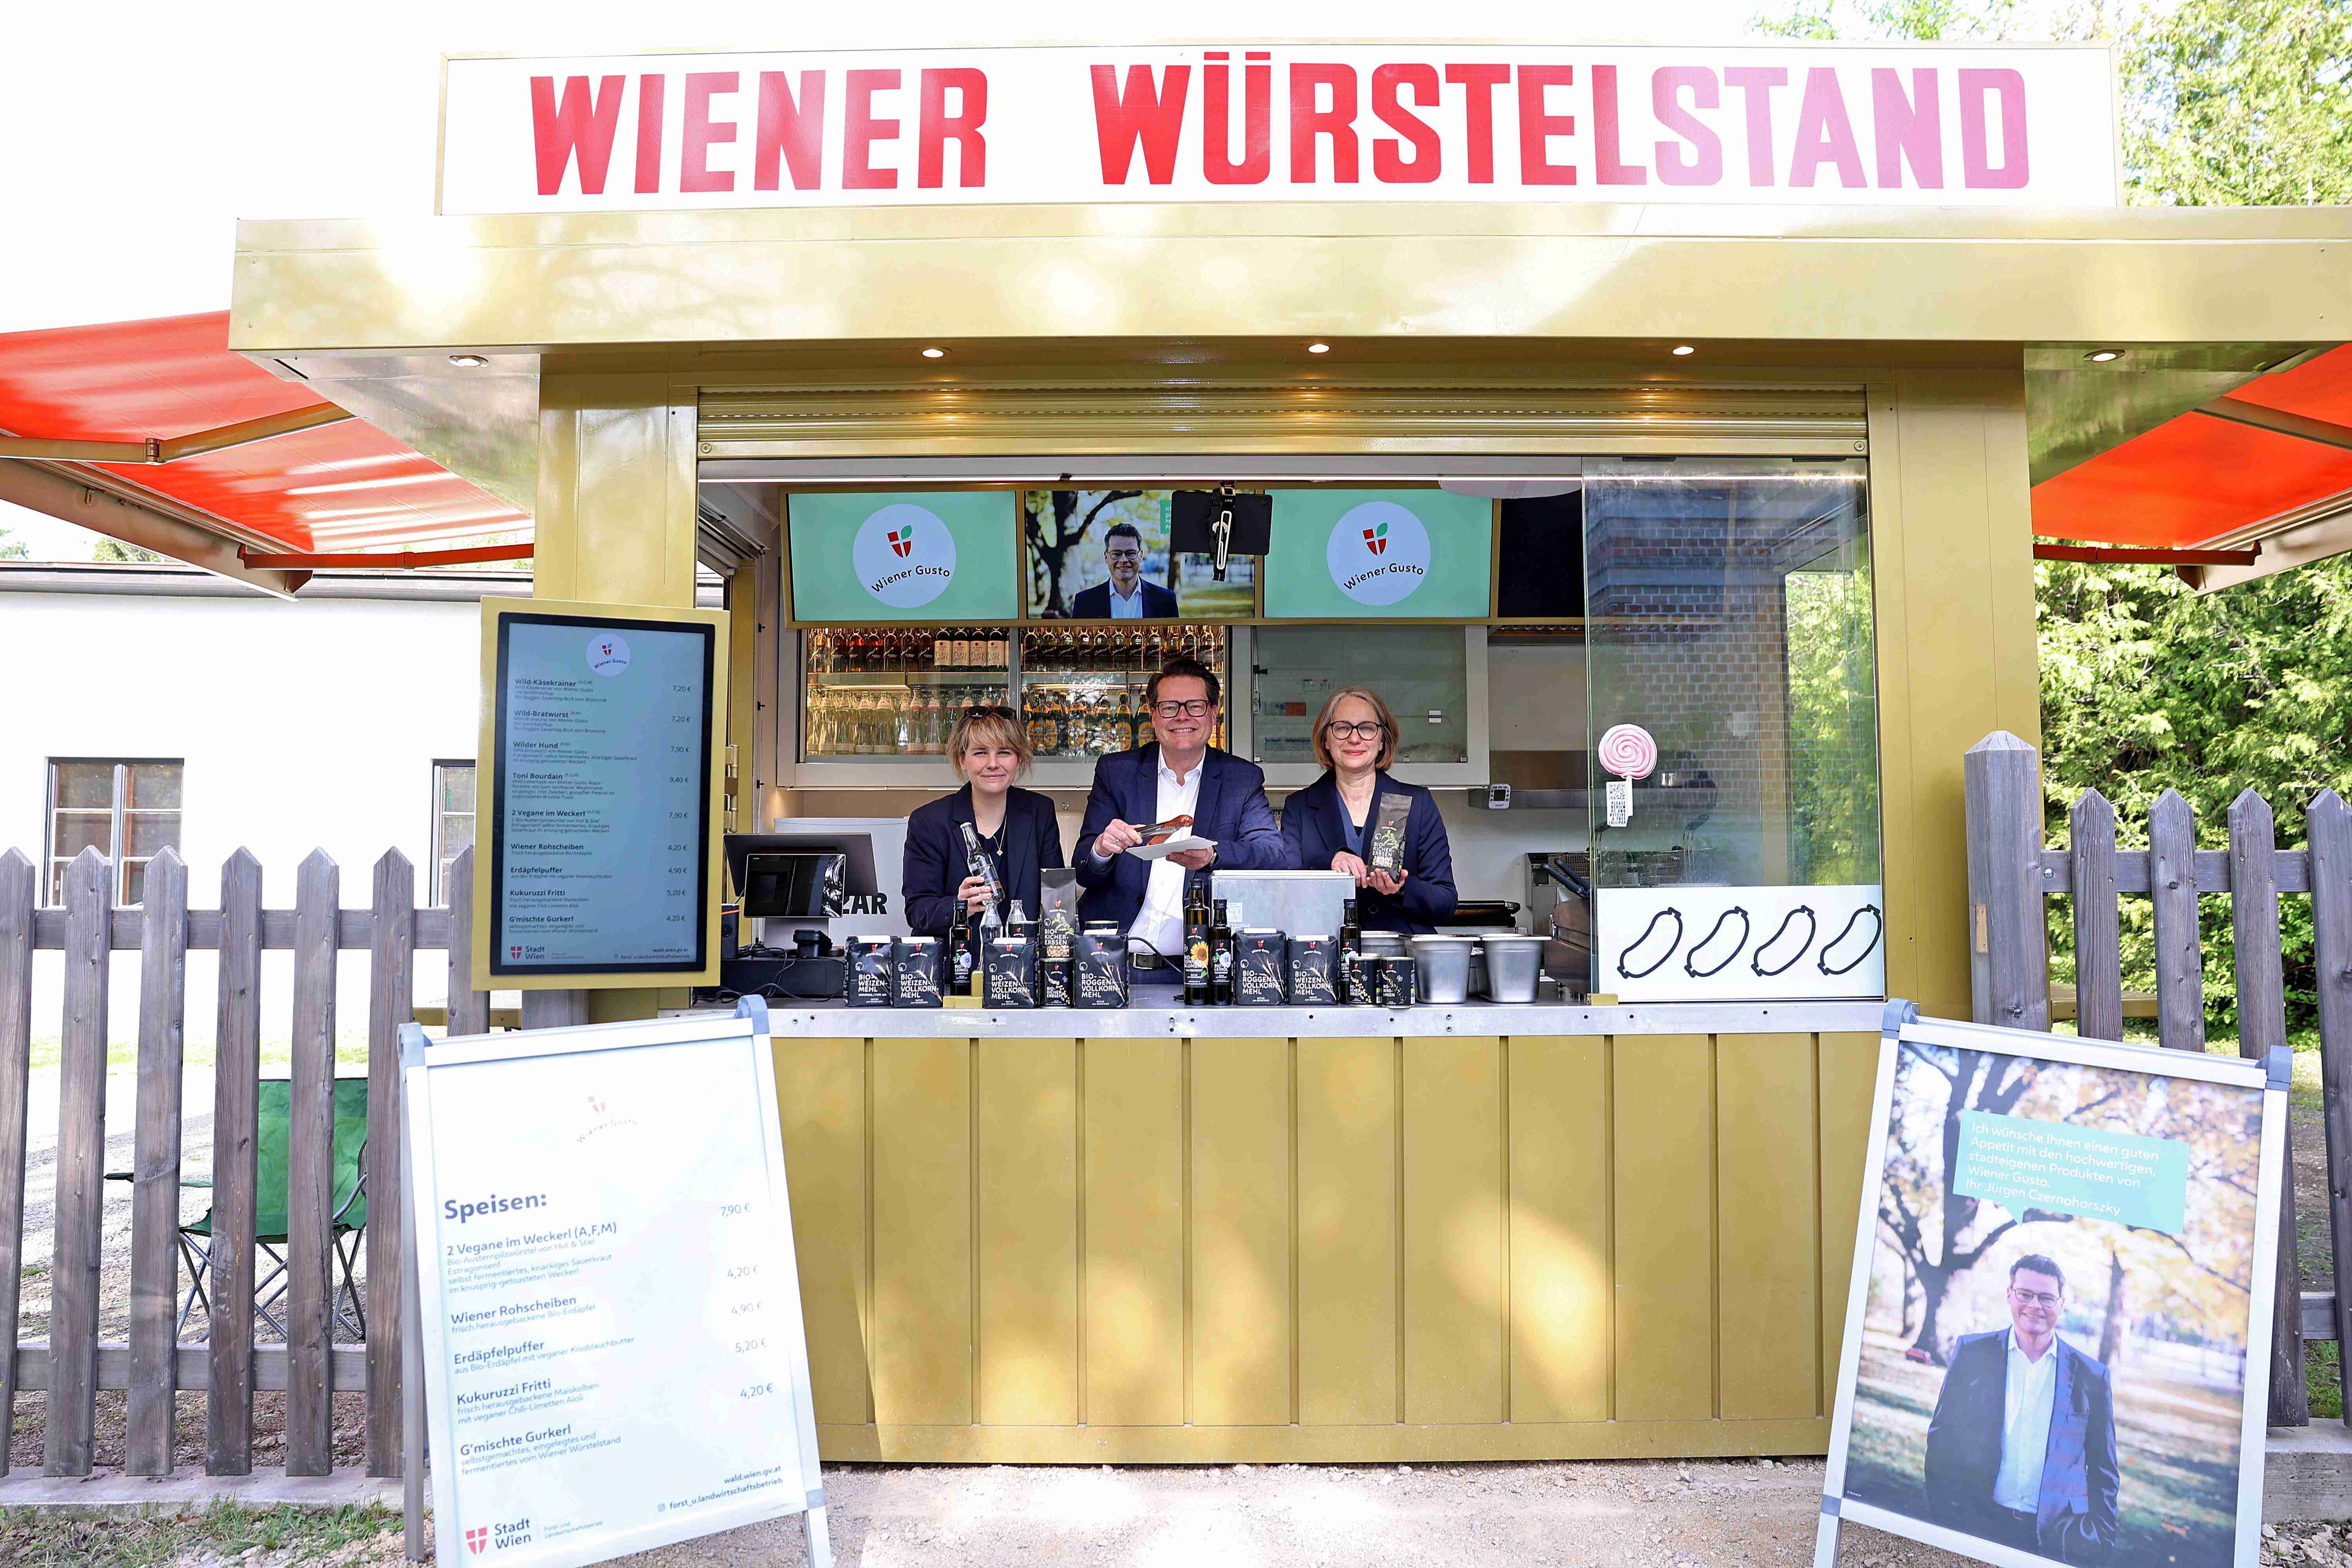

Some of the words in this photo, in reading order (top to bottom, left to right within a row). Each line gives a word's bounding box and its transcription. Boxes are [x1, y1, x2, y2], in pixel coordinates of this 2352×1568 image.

[531, 68, 988, 195] WIENER
[1091, 50, 2029, 189] WÜRSTELSTAND
[871, 567, 913, 594] Wiener
[916, 564, 951, 579] Gusto
[1344, 566, 1386, 590] Wiener
[1389, 562, 1424, 576] Gusto
[594, 659, 612, 669] Wiener
[515, 678, 576, 687] Wild-Käsekrainer
[672, 684, 686, 693] 7,20
[514, 710, 569, 718] Wild-Bratwurst
[671, 715, 685, 724] 7,20
[670, 745, 684, 754] 7,90
[669, 775, 683, 784] 9,40
[517, 809, 544, 817] Vegane
[667, 844, 681, 852] 4,20
[667, 867, 682, 875] 4,90
[666, 889, 681, 897] 5,20
[666, 915, 680, 923] 4,20
[1972, 1122, 1989, 1135] Ich
[1991, 1126, 2043, 1143] wünsche
[2046, 1134, 2080, 1149] Ihnen
[2083, 1141, 2118, 1155] einen
[2121, 1146, 2159, 1161] guten
[1970, 1136, 2014, 1153] Appetit
[2017, 1145, 2036, 1156] mit
[2039, 1147, 2062, 1161] den
[2065, 1151, 2155, 1178] hochwertigen,
[1968, 1165, 2010, 1181] Wiener
[2012, 1171, 2050, 1187] Gusto.
[1969, 1152, 2046, 1172] stadteigenen
[2049, 1163, 2113, 1183] Produkten
[2117, 1178, 2140, 1188] von
[1965, 1178, 1982, 1191] Ihr
[1984, 1181, 2026, 1198] Jürgen
[2028, 1188, 2120, 1216] Czernohorszky
[445, 1194, 546, 1223] Speisen:
[720, 1204, 741, 1219] 7,90
[744, 1203, 749, 1213] €
[446, 1245, 453, 1256] 2
[456, 1242, 503, 1255] Vegane
[506, 1237, 520, 1248] im
[523, 1229, 571, 1246] Weckerl
[574, 1223, 616, 1241] (A,F,M)
[554, 1242, 569, 1251] Hut
[579, 1239, 594, 1248] Stiel
[447, 1262, 500, 1276] Estragonsenf
[447, 1275, 472, 1285] selbst
[473, 1267, 530, 1281] fermentiertes,
[531, 1261, 570, 1273] knackiges
[571, 1254, 612, 1267] Sauerkraut
[726, 1266, 750, 1281] 4,20
[460, 1273, 546, 1292] knusprig-getoasteten
[547, 1268, 579, 1279] Weckerl
[450, 1308, 496, 1325] Wiener
[499, 1296, 576, 1318] Rohscheiben
[451, 1323, 475, 1334] frisch
[475, 1313, 546, 1330] herausgebackene
[547, 1304, 595, 1319] Bio-Erdäpfel
[731, 1302, 754, 1317] 4,90
[454, 1340, 544, 1365] Erdäpfelpuffer
[470, 1356, 521, 1372] Bio-Erdäpfel
[522, 1353, 535, 1363] mit
[536, 1350, 567, 1360] veganer
[570, 1338, 634, 1355] Knoblauchbutter
[734, 1339, 758, 1354] 5,20
[760, 1338, 766, 1349] €
[456, 1384, 519, 1406] Kukuruzzi
[522, 1378, 550, 1395] Fritti
[457, 1403, 480, 1415] frisch
[482, 1392, 552, 1410] herausgebackene
[554, 1383, 598, 1398] Maiskolben
[740, 1385, 764, 1400] 4,20
[766, 1383, 773, 1395] €
[457, 1415, 472, 1425] mit
[473, 1411, 506, 1422] veganer
[507, 1399, 564, 1416] Chili-Limetten
[566, 1395, 583, 1405] Aioli
[525, 1423, 570, 1443] Gurkerl
[462, 1446, 532, 1466] selbstgemachtes,
[533, 1436, 579, 1452] eingelegtes
[580, 1432, 596, 1442] und
[462, 1458, 517, 1475] fermentiertes
[519, 1456, 537, 1464] vom
[537, 1448, 567, 1460] Wiener
[569, 1437, 621, 1454] Würstelstand
[723, 1465, 780, 1484] wald.wien.gv.at
[669, 1477, 783, 1509] forst_u.landwirtschaftsbetrieb
[494, 1517, 530, 1536] Stadt
[495, 1533, 531, 1550] Wien
